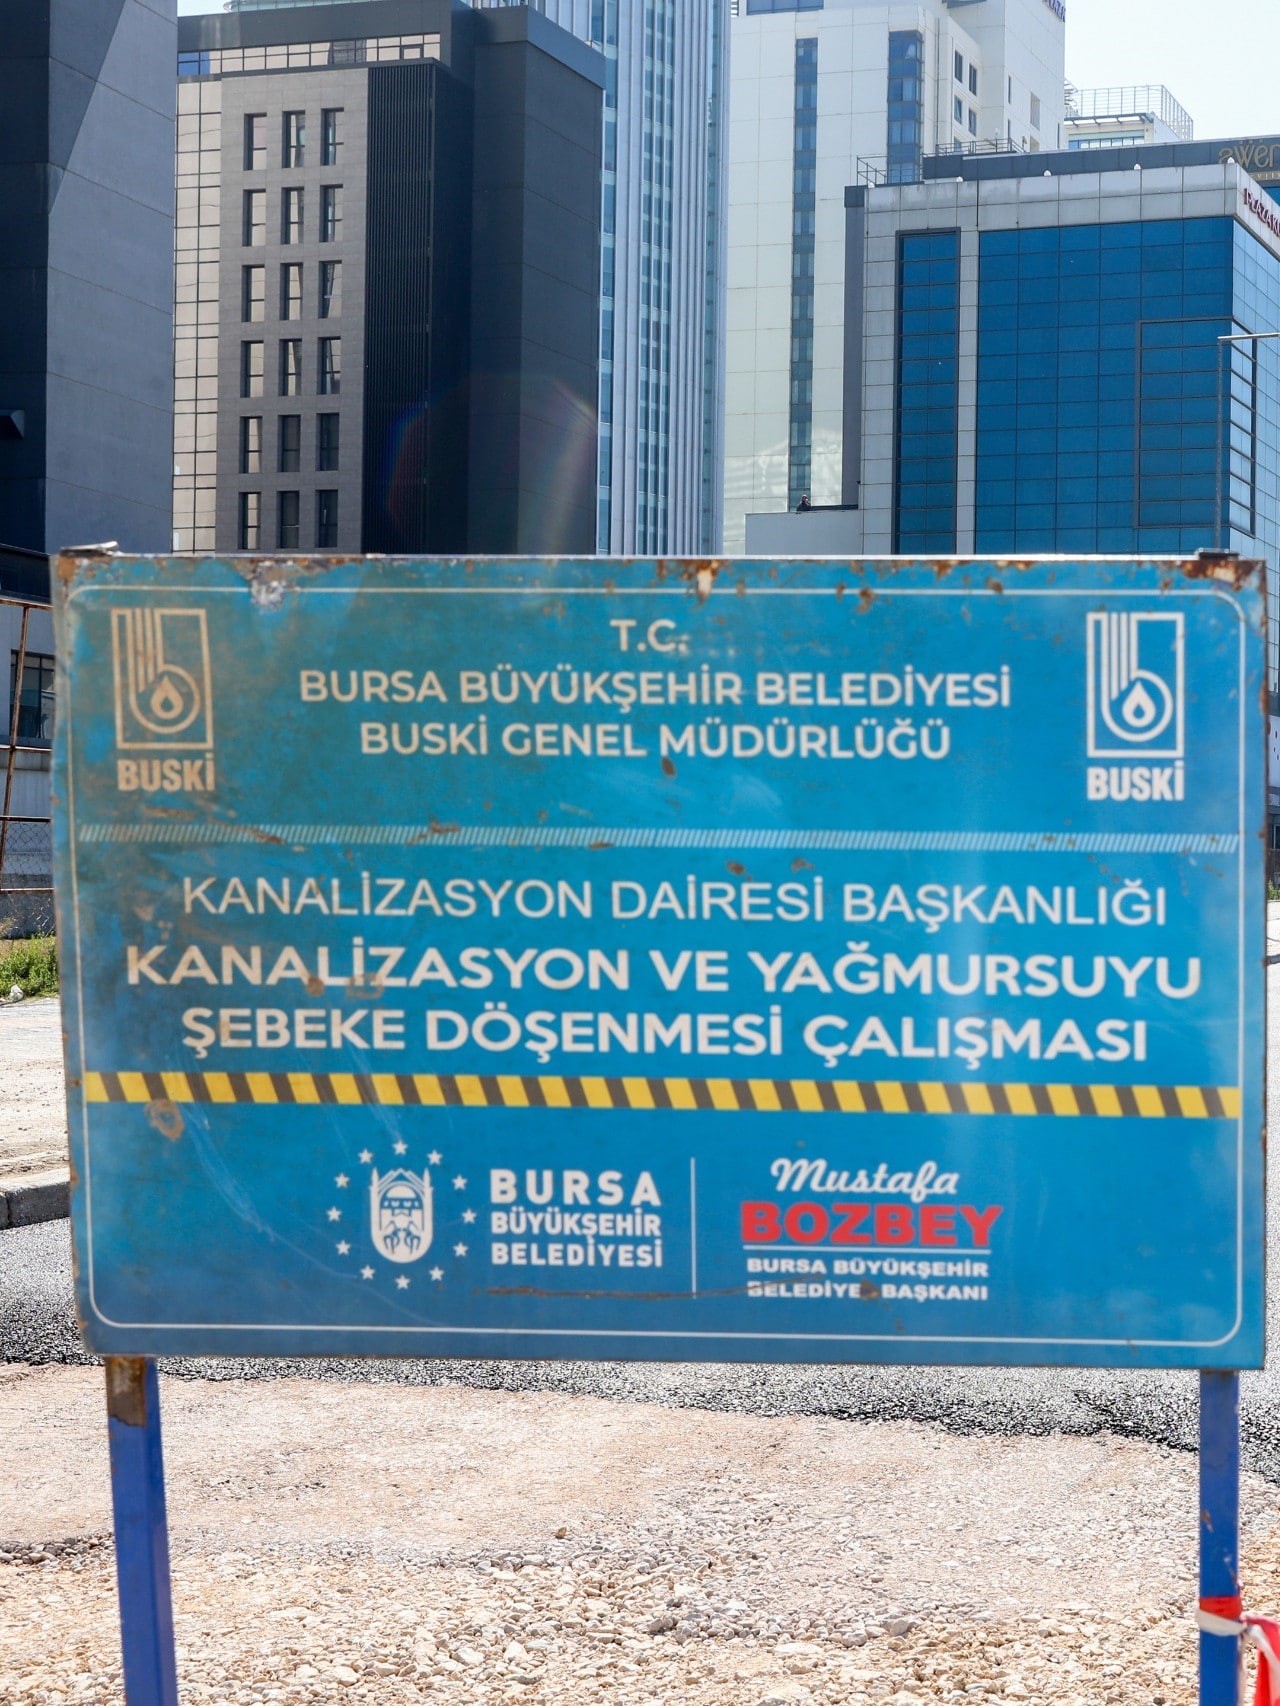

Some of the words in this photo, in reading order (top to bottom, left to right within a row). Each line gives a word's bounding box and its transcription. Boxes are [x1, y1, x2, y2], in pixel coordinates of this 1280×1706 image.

[300, 670, 447, 703] BURSA
[460, 663, 742, 713] BÜYÜKŞEHİR
[756, 664, 1012, 708] BELEDİYESİ
[361, 714, 488, 755] BUSKİ
[502, 723, 646, 757] GENEL
[660, 718, 951, 760] MÜDÜRLÜĞÜ
[117, 752, 215, 792] BUSKİ
[1086, 760, 1185, 801] BUSKİ
[183, 871, 592, 918] KANALİZASYON
[611, 874, 824, 922] DAİRESİ
[844, 878, 1167, 933] BAŞKANLIĞI
[127, 937, 629, 990] KANALİZASYON
[650, 950, 729, 992] VE
[748, 942, 1200, 998] YAĞMURSUYU
[182, 1007, 405, 1059] ŞEBEKE
[426, 1003, 782, 1063] DÖŞENMESİ
[804, 1015, 1147, 1070] ÇALIŞMASI
[489, 1168, 662, 1206] BURSA
[771, 1159, 961, 1204] Mustafa
[490, 1206, 661, 1240] BÜYÜKŞEHİR
[740, 1202, 1003, 1247] BOZBEY
[491, 1238, 663, 1267] BELEDİYESİ
[746, 1259, 826, 1275] BURSA
[832, 1257, 989, 1279] BÜYÜKŞEHİR
[748, 1279, 860, 1298] BELEDİYE
[882, 1283, 989, 1302] BAŞKANI
